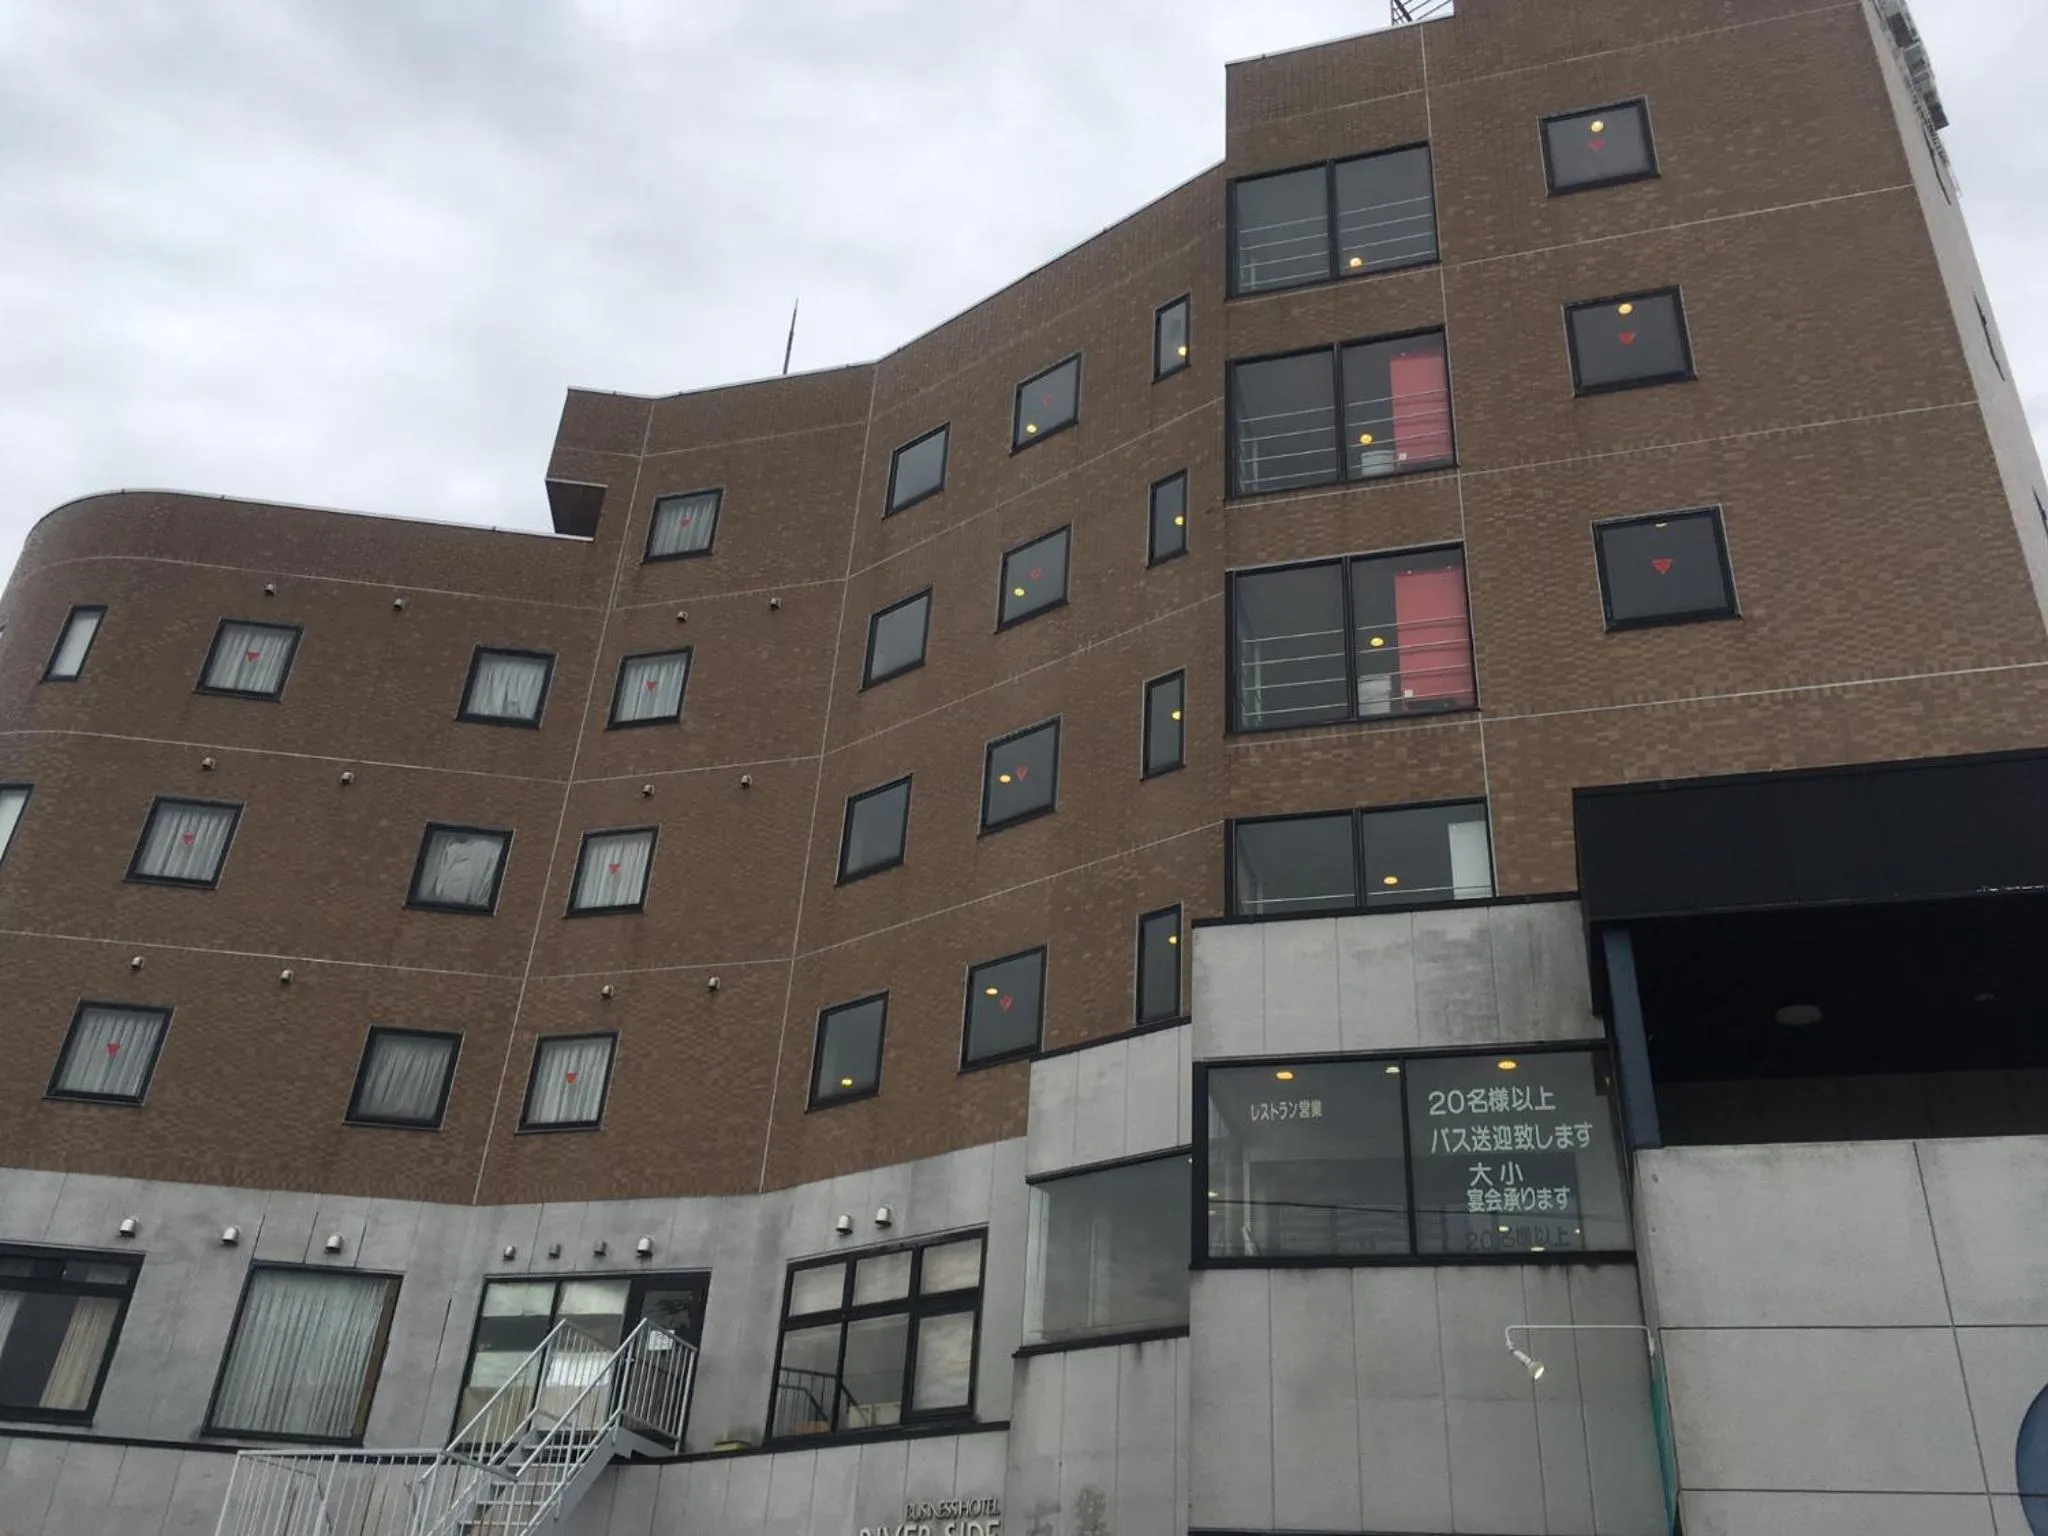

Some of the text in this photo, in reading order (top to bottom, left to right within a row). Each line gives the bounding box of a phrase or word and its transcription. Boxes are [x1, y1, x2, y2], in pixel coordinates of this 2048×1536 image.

[1428, 1086, 1556, 1115] 20名様以上
[1431, 1121, 1593, 1154] バス送迎致します
[1467, 1185, 1570, 1213] 宴会承ります
